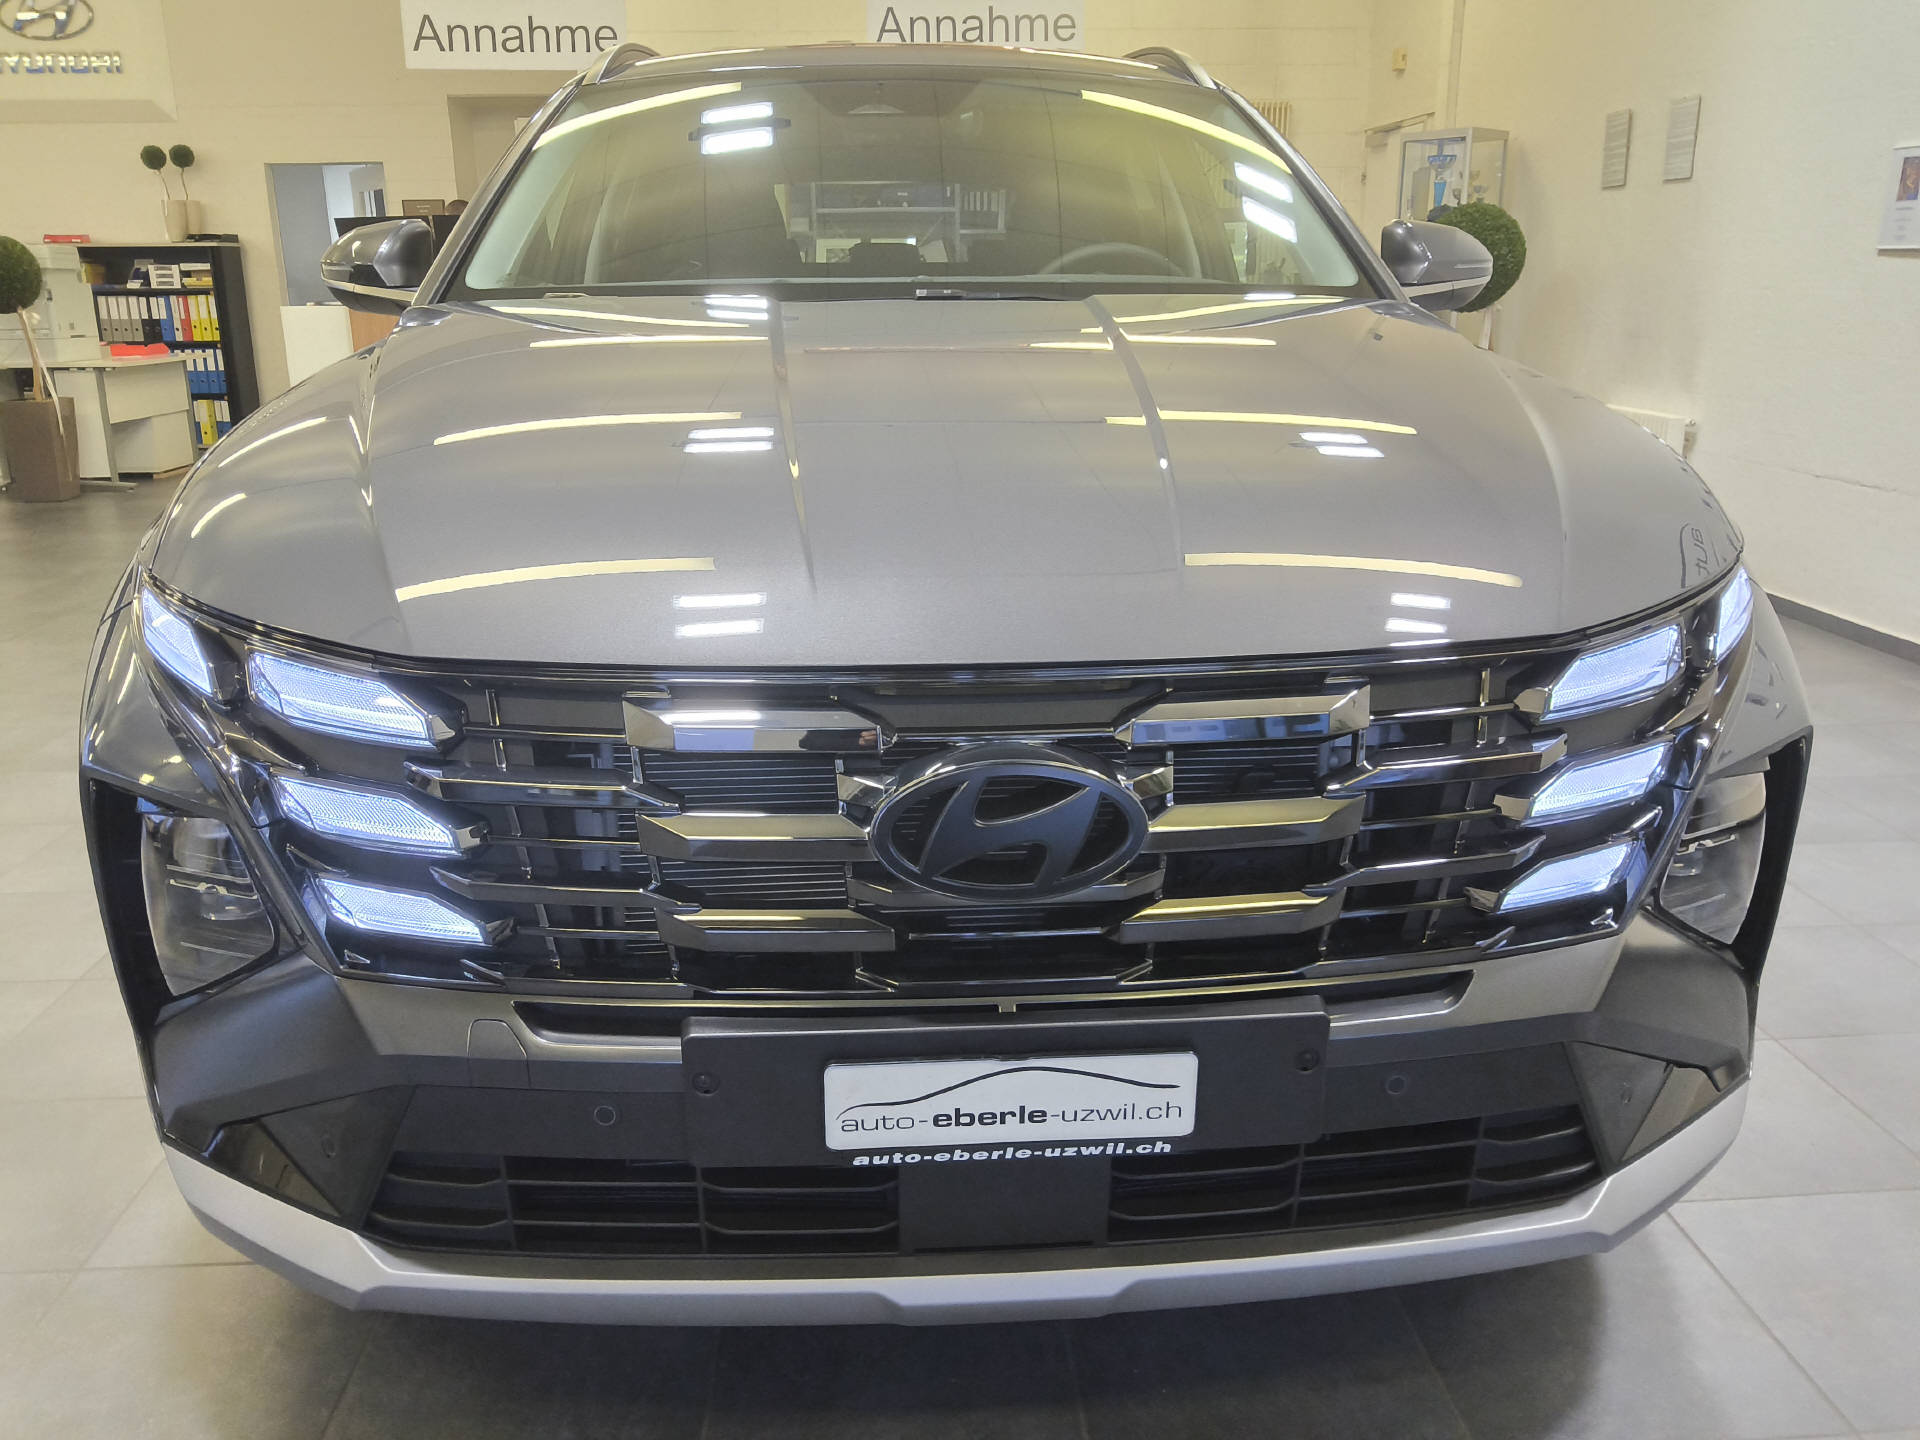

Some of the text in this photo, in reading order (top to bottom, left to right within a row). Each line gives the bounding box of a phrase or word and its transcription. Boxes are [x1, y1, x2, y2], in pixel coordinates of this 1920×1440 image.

[413, 14, 618, 53] Annahme
[876, 5, 1076, 43] Annahme
[0, 54, 122, 74] YUNDAI
[841, 1101, 1182, 1132] auto-eberle-uzwil.ch
[852, 1141, 1172, 1166] auto-eberle-uzwil.ch
